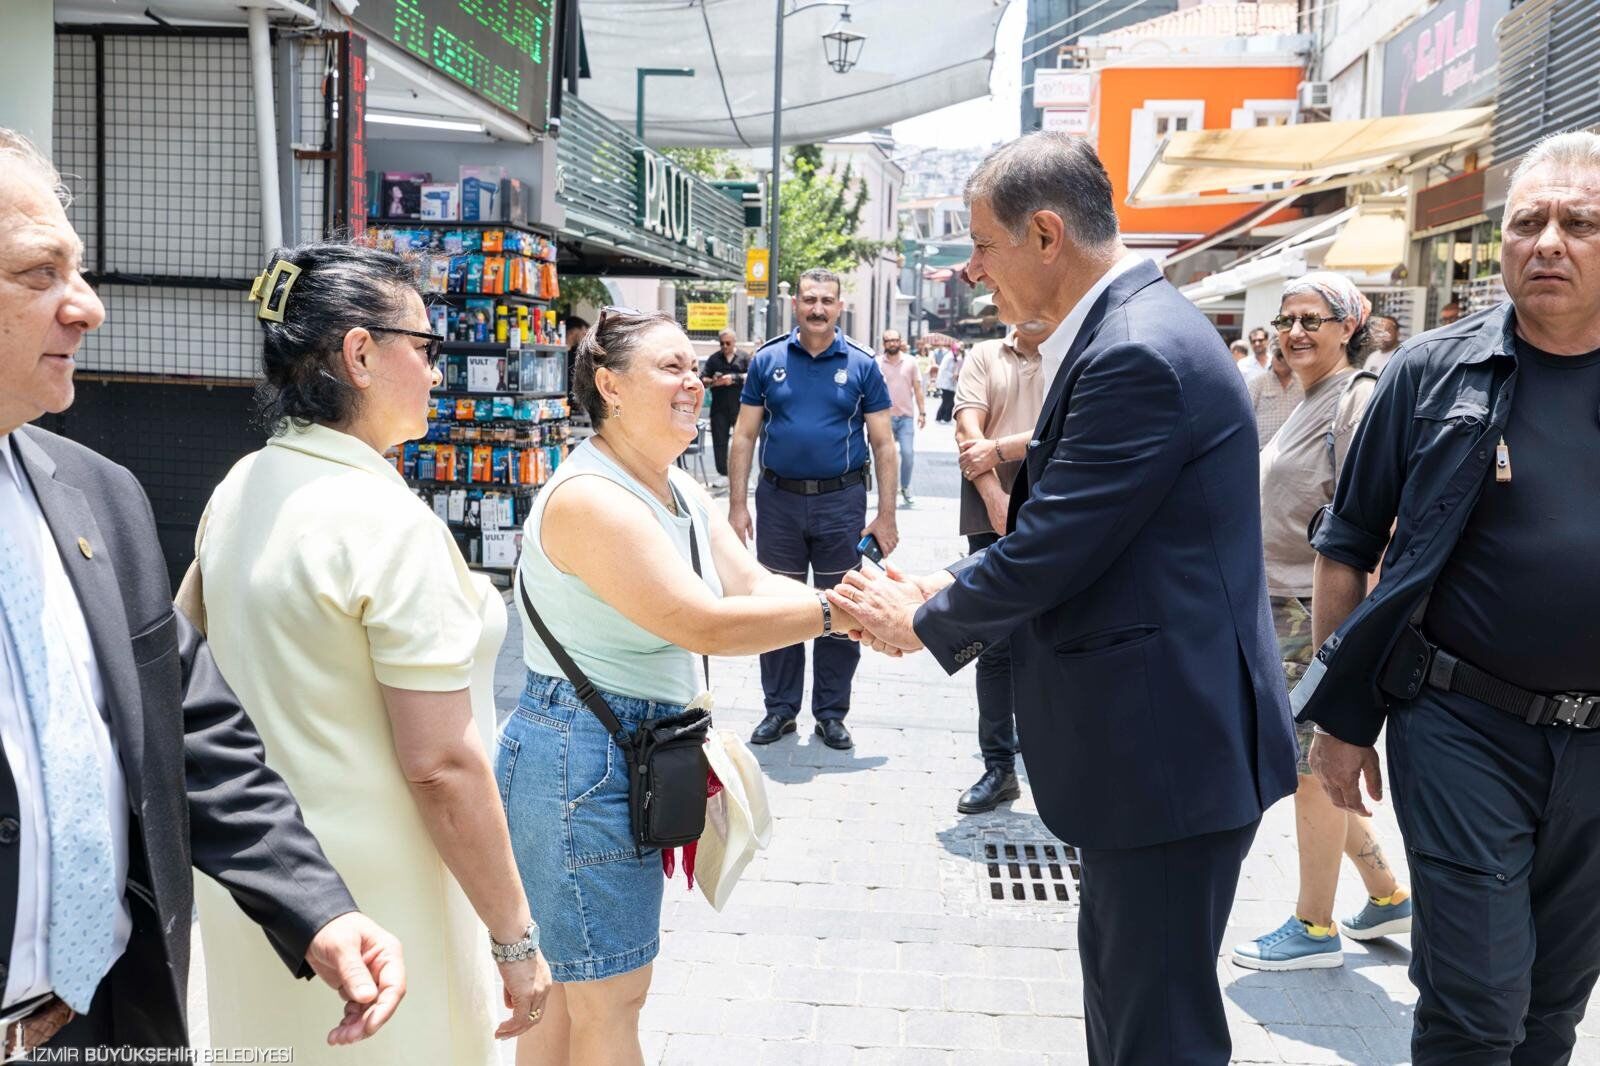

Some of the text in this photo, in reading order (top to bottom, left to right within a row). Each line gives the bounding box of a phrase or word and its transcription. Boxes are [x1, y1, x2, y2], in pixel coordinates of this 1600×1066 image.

[643, 150, 698, 248] PAUL
[470, 358, 489, 366] VULT
[485, 533, 505, 541] VULT
